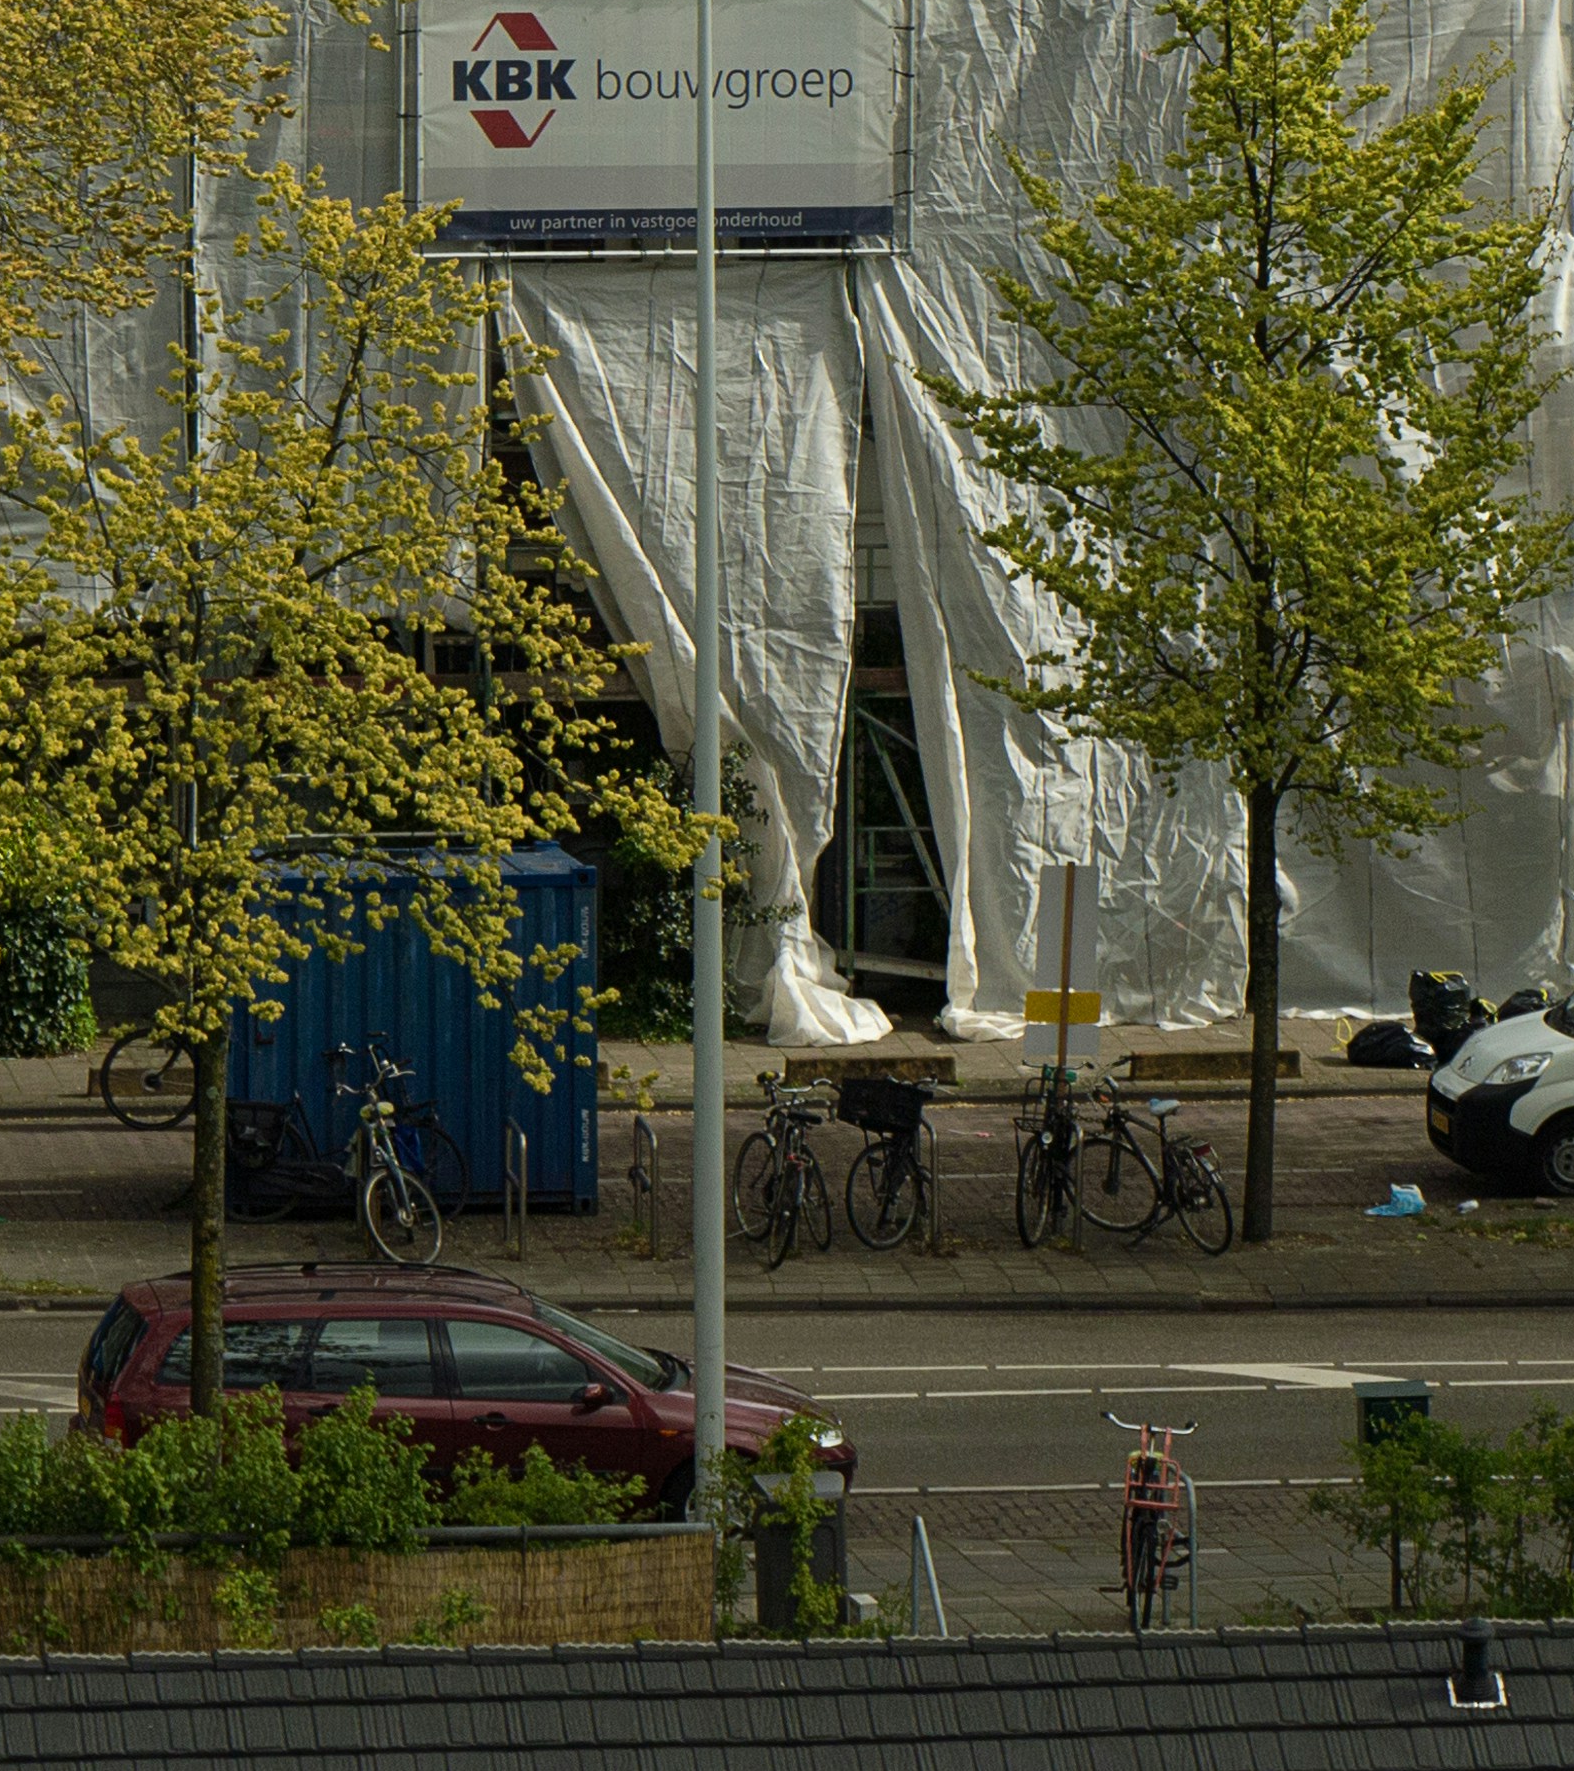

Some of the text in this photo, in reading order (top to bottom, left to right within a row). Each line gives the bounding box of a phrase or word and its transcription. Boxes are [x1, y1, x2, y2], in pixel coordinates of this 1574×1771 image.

[452, 59, 576, 101] KBK
[510, 212, 803, 232] uw partner in vastgoeonderhoud
